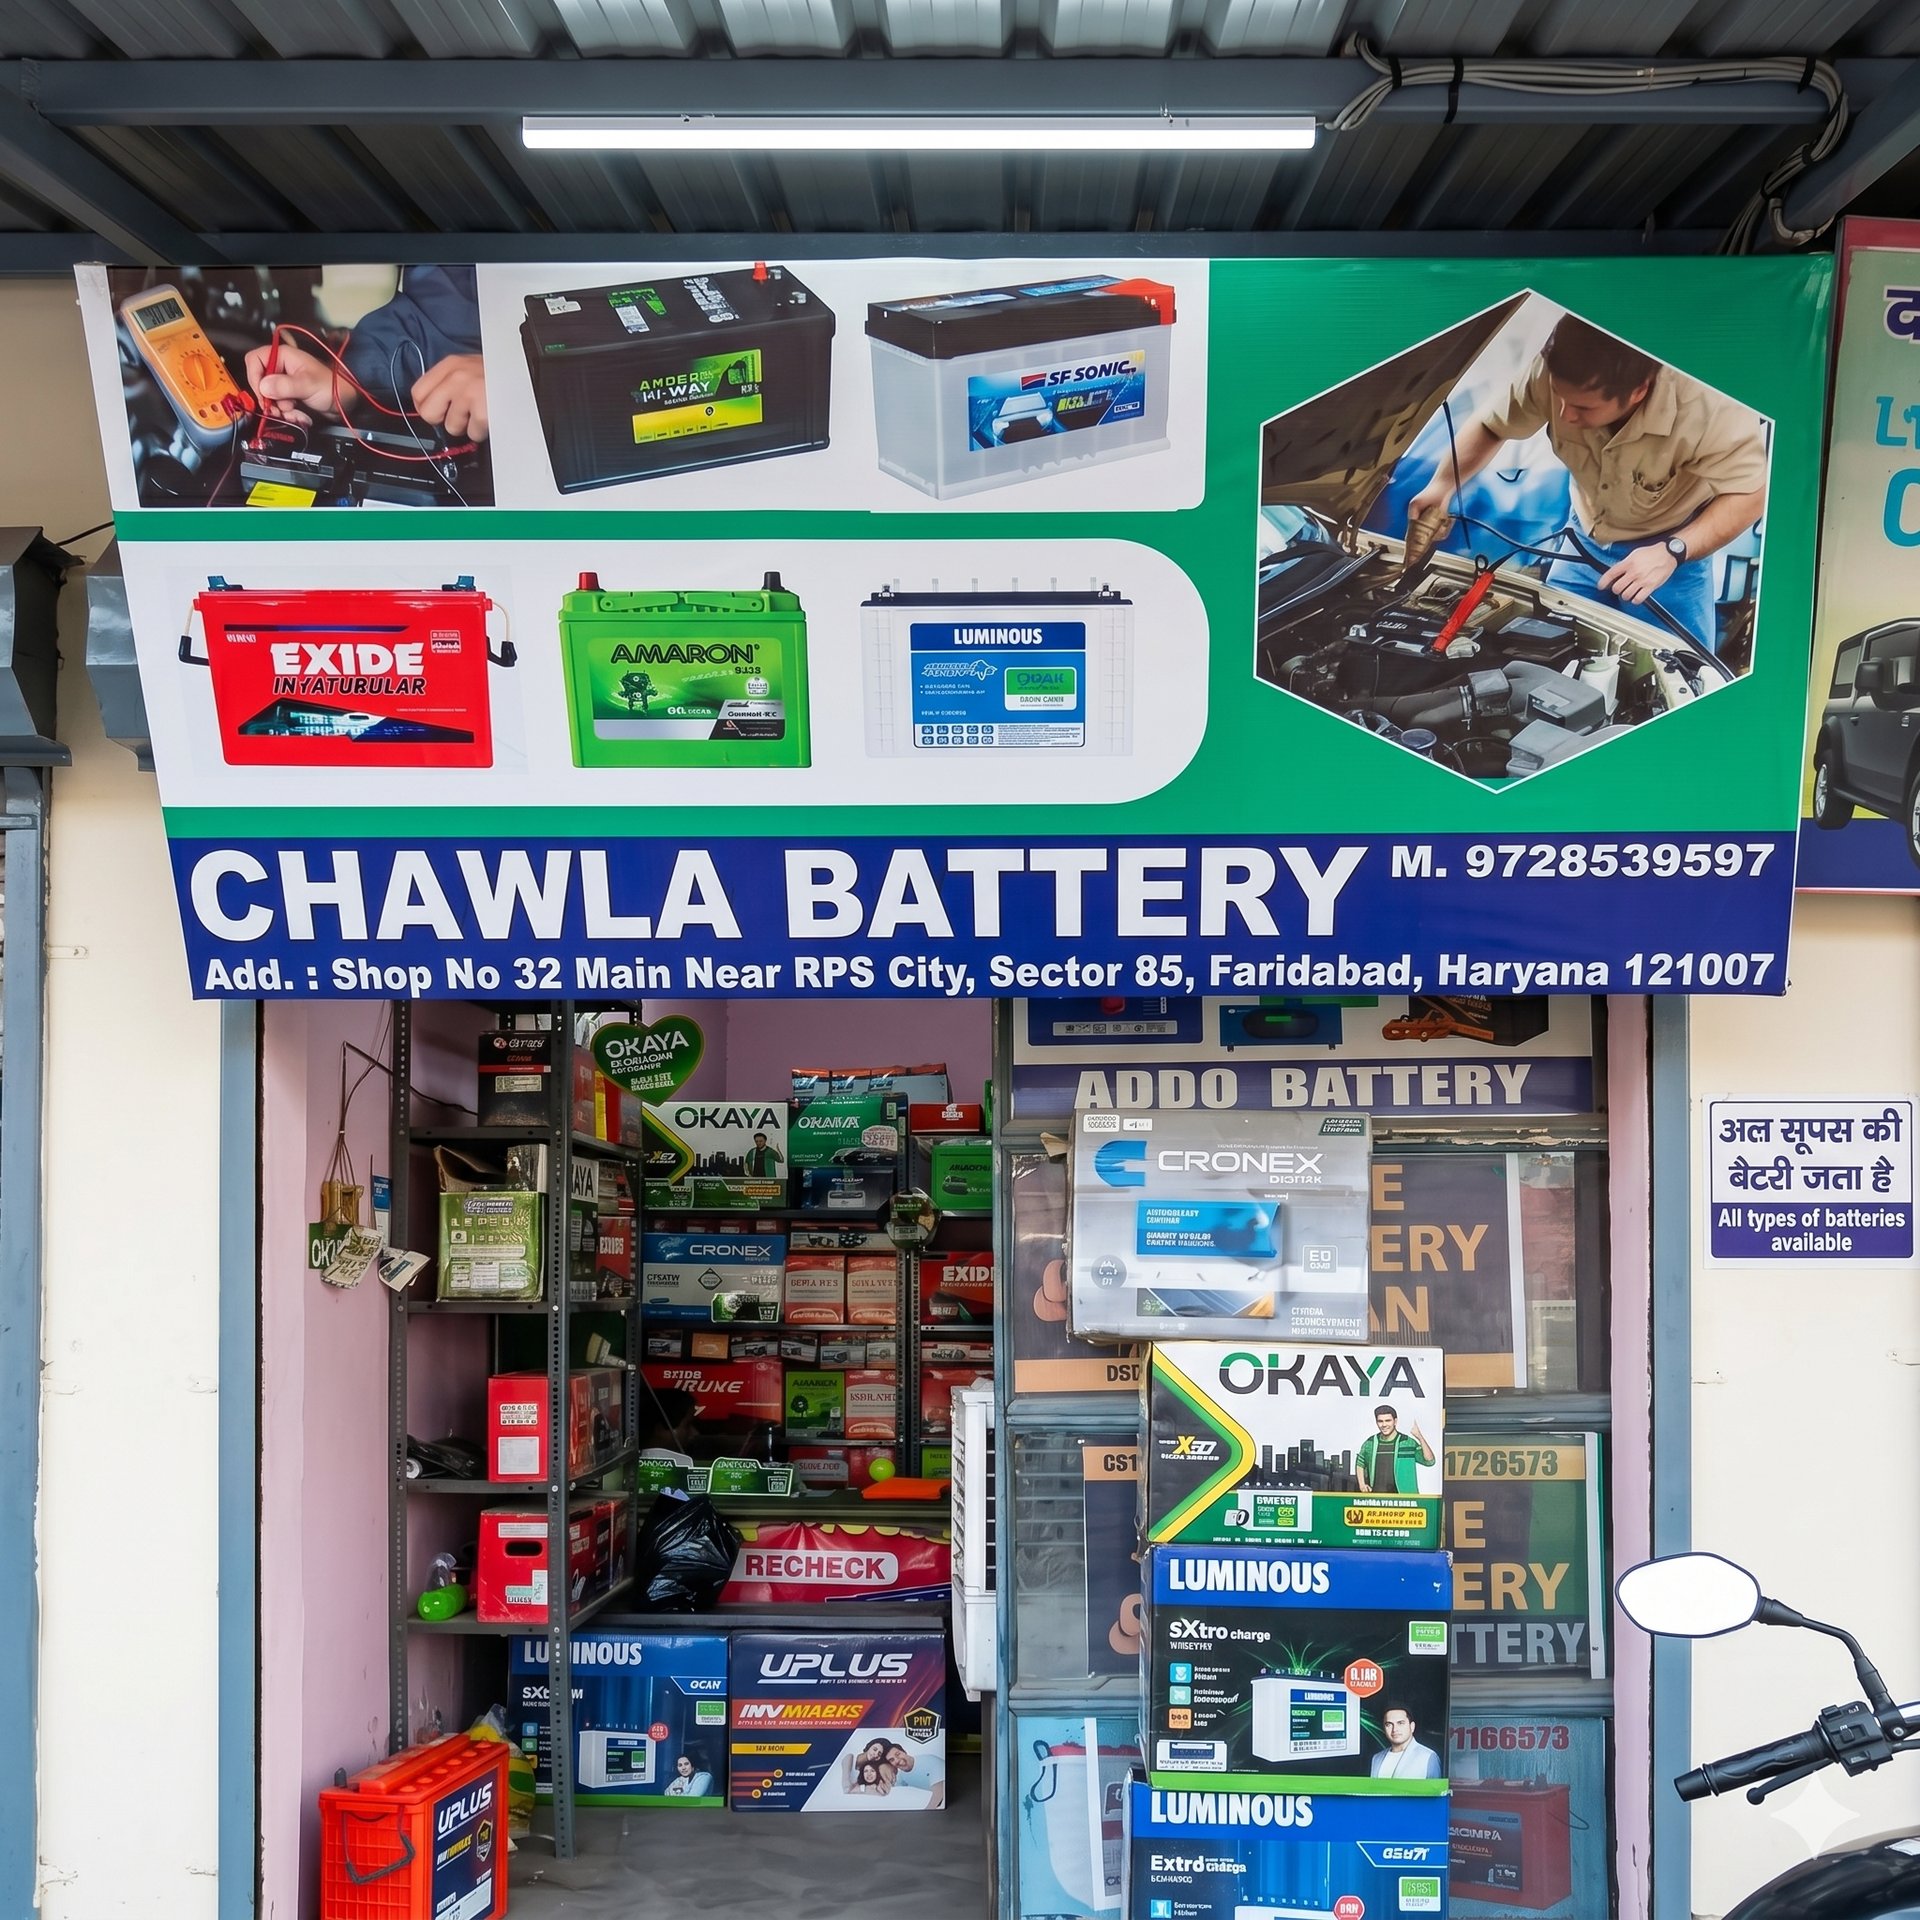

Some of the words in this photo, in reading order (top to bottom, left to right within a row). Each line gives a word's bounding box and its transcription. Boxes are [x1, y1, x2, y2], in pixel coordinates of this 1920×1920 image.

[1047, 370, 1072, 387] SF
[953, 627, 1043, 646] LUMINOUS
[270, 642, 424, 676] EXIDE
[610, 643, 754, 664] AMARON
[1391, 845, 1447, 878] M.
[1465, 843, 1775, 878] 9728539597
[190, 849, 743, 942] CHAWLA
[784, 846, 1369, 939] BATTERY
[204, 958, 294, 991] Add.
[331, 957, 431, 998] Shop
[455, 957, 501, 990] No
[513, 957, 563, 990] 32
[575, 957, 671, 990] Main
[693, 956, 782, 989] Near
[794, 955, 875, 988] RPS
[888, 955, 975, 997] City,
[989, 955, 1123, 988] Sector
[1135, 954, 1195, 994] 85,
[1210, 954, 1423, 993] Faridabad,
[1438, 953, 1607, 996] Haryana
[1625, 952, 1775, 986] 121007
[605, 1030, 690, 1059] OKAYA
[1073, 1069, 1238, 1110] ADDO
[1270, 1063, 1532, 1109] BATTERY
[674, 1106, 781, 1130] OKAYA
[1862, 1107, 1904, 1143] की
[1158, 1149, 1324, 1175] CRONEX
[1728, 1155, 1795, 1191] बैटरी
[1801, 1166, 1864, 1191] जता
[1870, 1155, 1895, 1194] है
[573, 1164, 595, 1198] AYA
[1718, 1208, 1742, 1228] All
[1747, 1209, 1797, 1233] types
[1801, 1208, 1821, 1228] of
[1825, 1208, 1907, 1228] batteries
[689, 1244, 772, 1258] CRONEX
[1771, 1232, 1853, 1252] available
[1219, 1351, 1426, 1399] OKAYA
[1445, 1450, 1559, 1477] 1726573
[745, 1554, 886, 1581] RECHECK
[1169, 1558, 1330, 1595] LUMINOUS
[1169, 1618, 1229, 1640] sXtro
[1230, 1628, 1271, 1643] charge
[523, 1640, 642, 1666] LUINOUS
[759, 1653, 914, 1678] UPLUS
[437, 1781, 493, 1835] UPLUS
[1151, 1790, 1314, 1828] LUMINOUS
